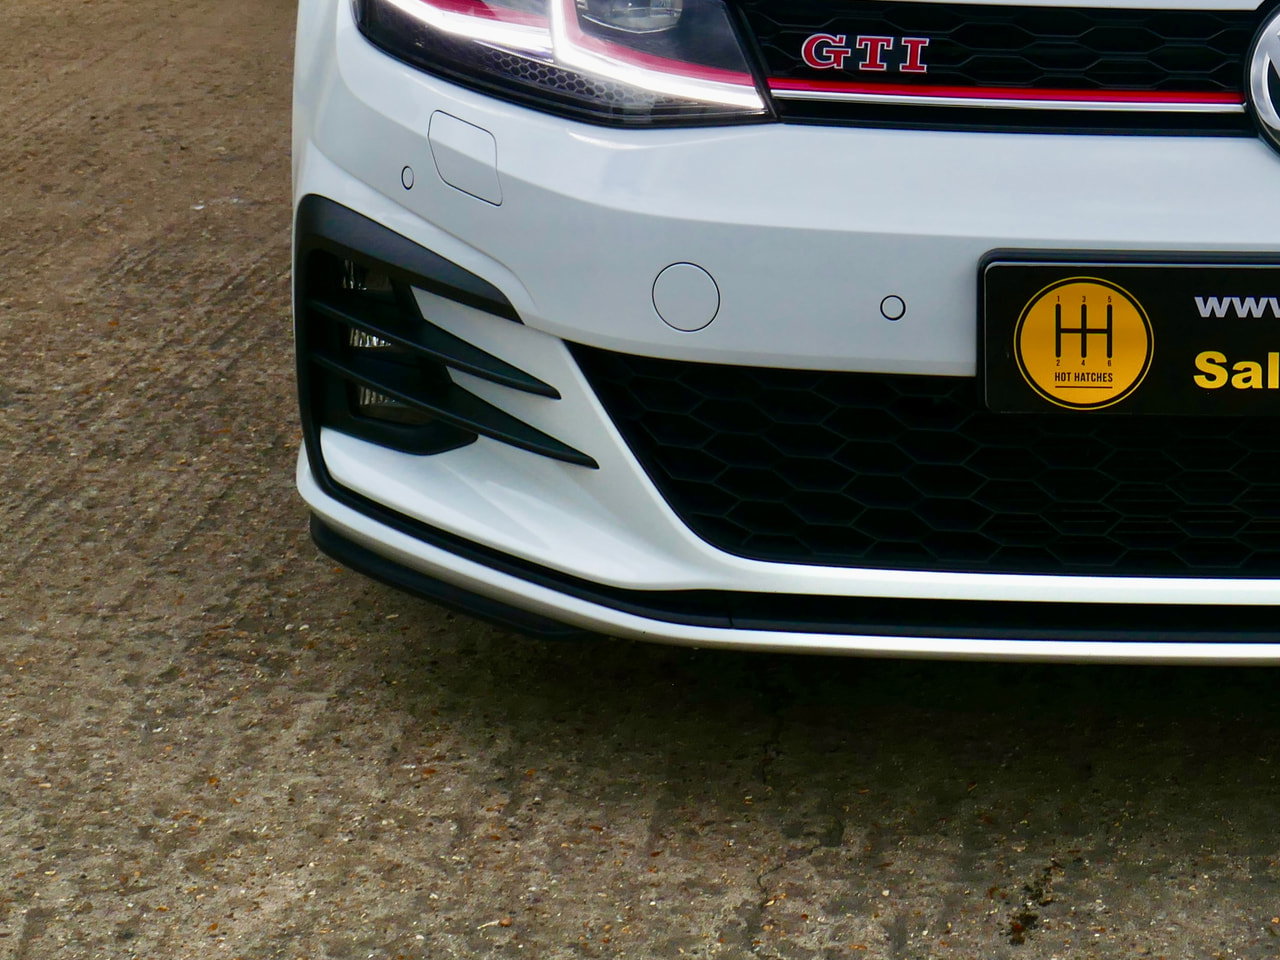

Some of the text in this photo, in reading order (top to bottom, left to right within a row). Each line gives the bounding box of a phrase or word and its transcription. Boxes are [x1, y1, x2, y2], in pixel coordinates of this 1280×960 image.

[801, 32, 929, 74] GTI
[1054, 372, 1113, 383] HOT HATCHES
